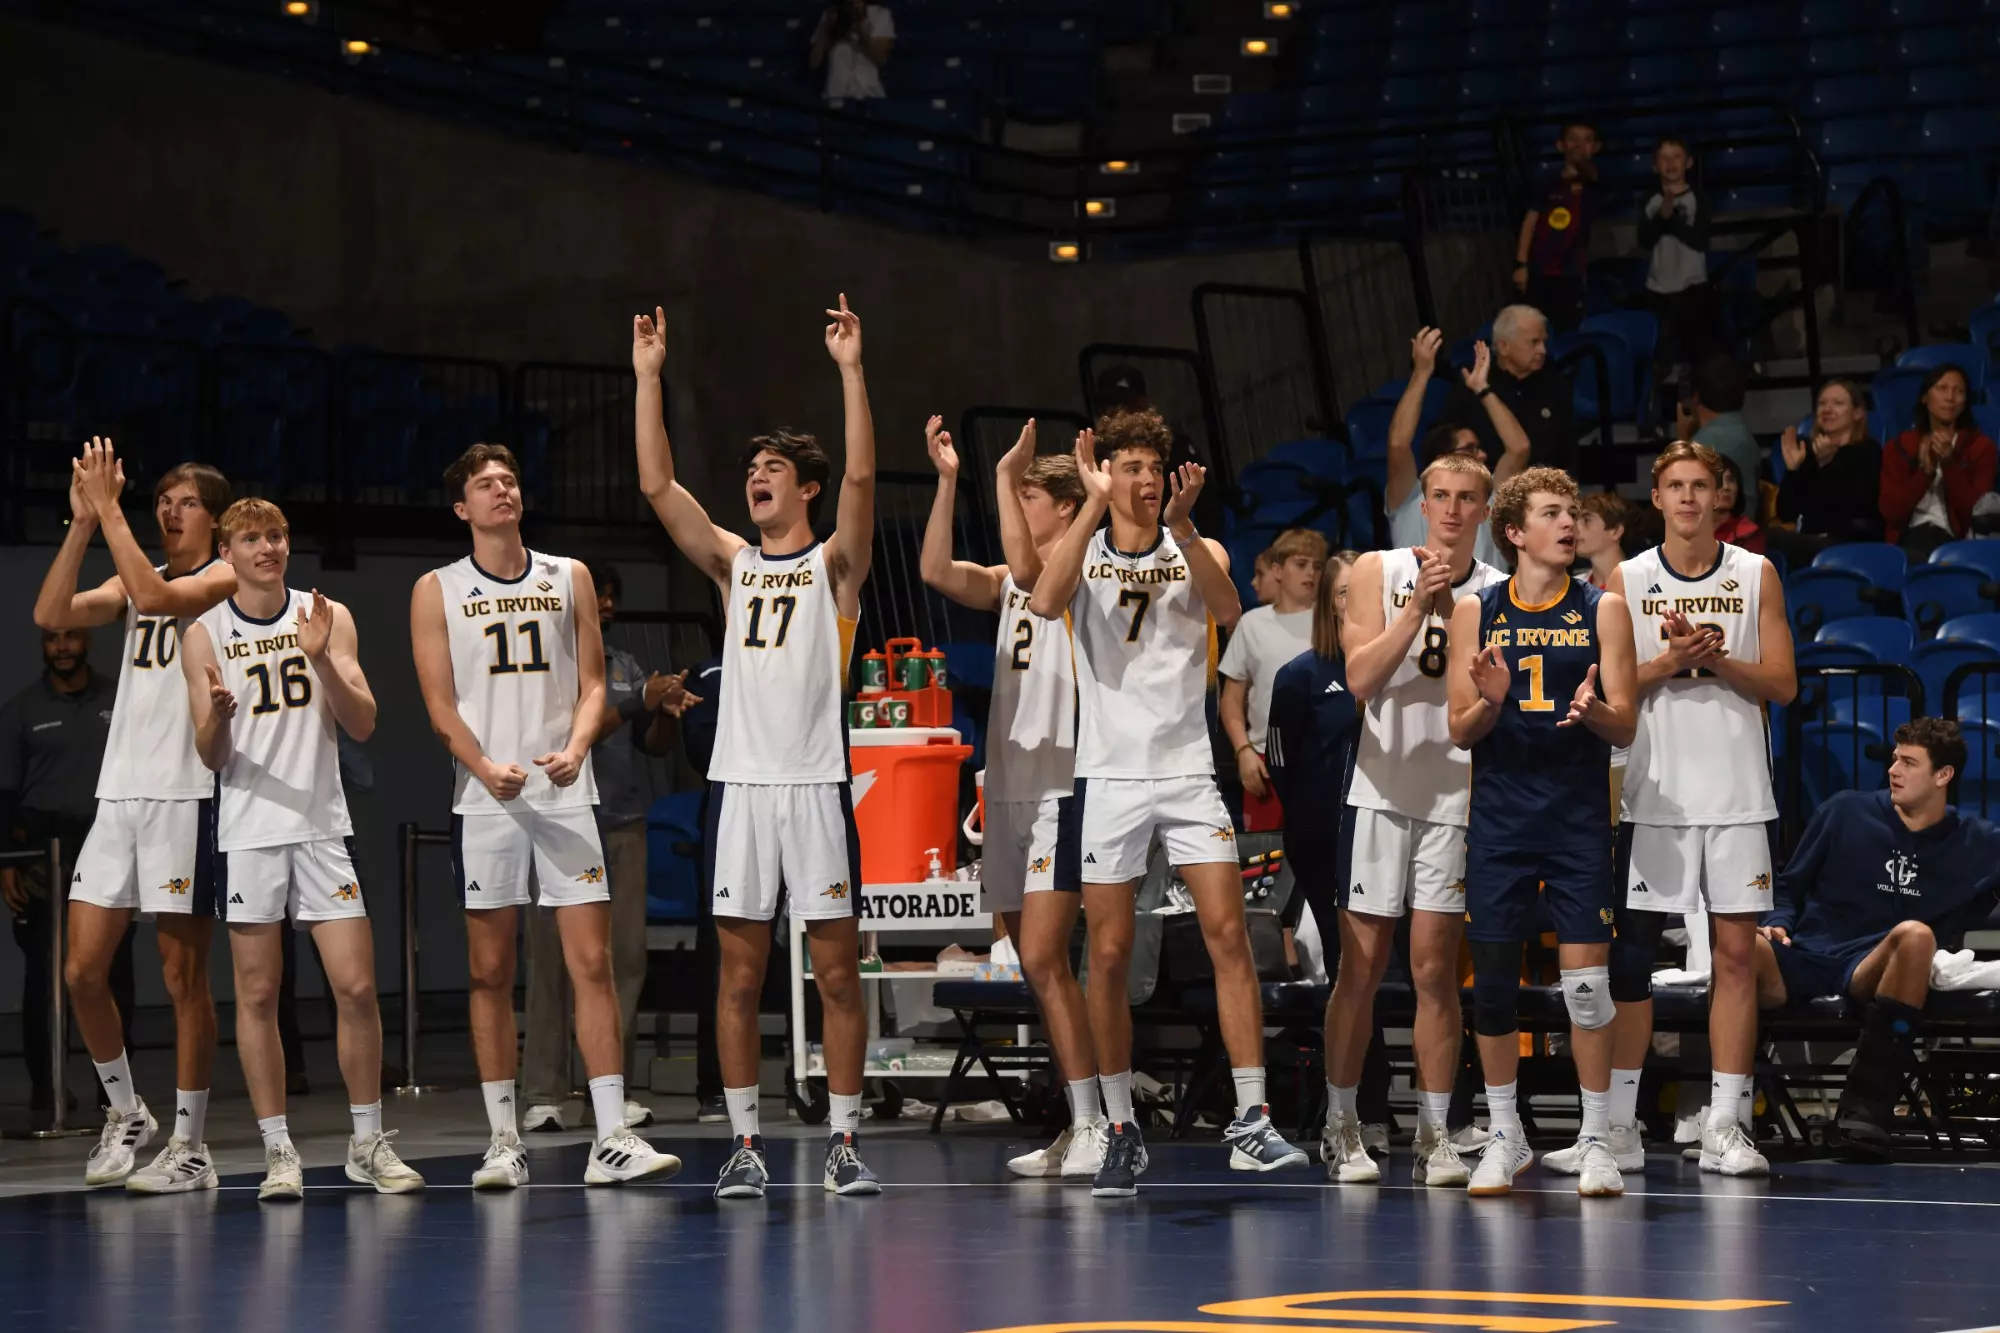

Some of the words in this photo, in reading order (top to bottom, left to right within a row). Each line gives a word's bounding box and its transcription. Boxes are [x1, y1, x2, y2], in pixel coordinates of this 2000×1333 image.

[1115, 565, 1186, 584] IRVINE
[462, 600, 491, 618] UC
[496, 597, 563, 613] IRVINE
[1118, 588, 1150, 643] 7
[1641, 599, 1667, 616] UC
[1674, 597, 1744, 614] IRVINE
[744, 595, 797, 649] 17
[132, 616, 178, 669] 10
[223, 643, 251, 660] UC
[254, 633, 299, 655] IRVI
[483, 619, 550, 676] 11
[1011, 617, 1033, 671] 2
[1485, 629, 1511, 647] UC
[1516, 628, 1590, 647] IRVINE
[1418, 626, 1448, 678] 8
[245, 655, 313, 716] 16
[1518, 654, 1555, 712] 1
[861, 706, 875, 721] G
[894, 705, 907, 720] G
[1877, 883, 1921, 897] VOLLYBALL
[859, 893, 975, 919] ATORADE
